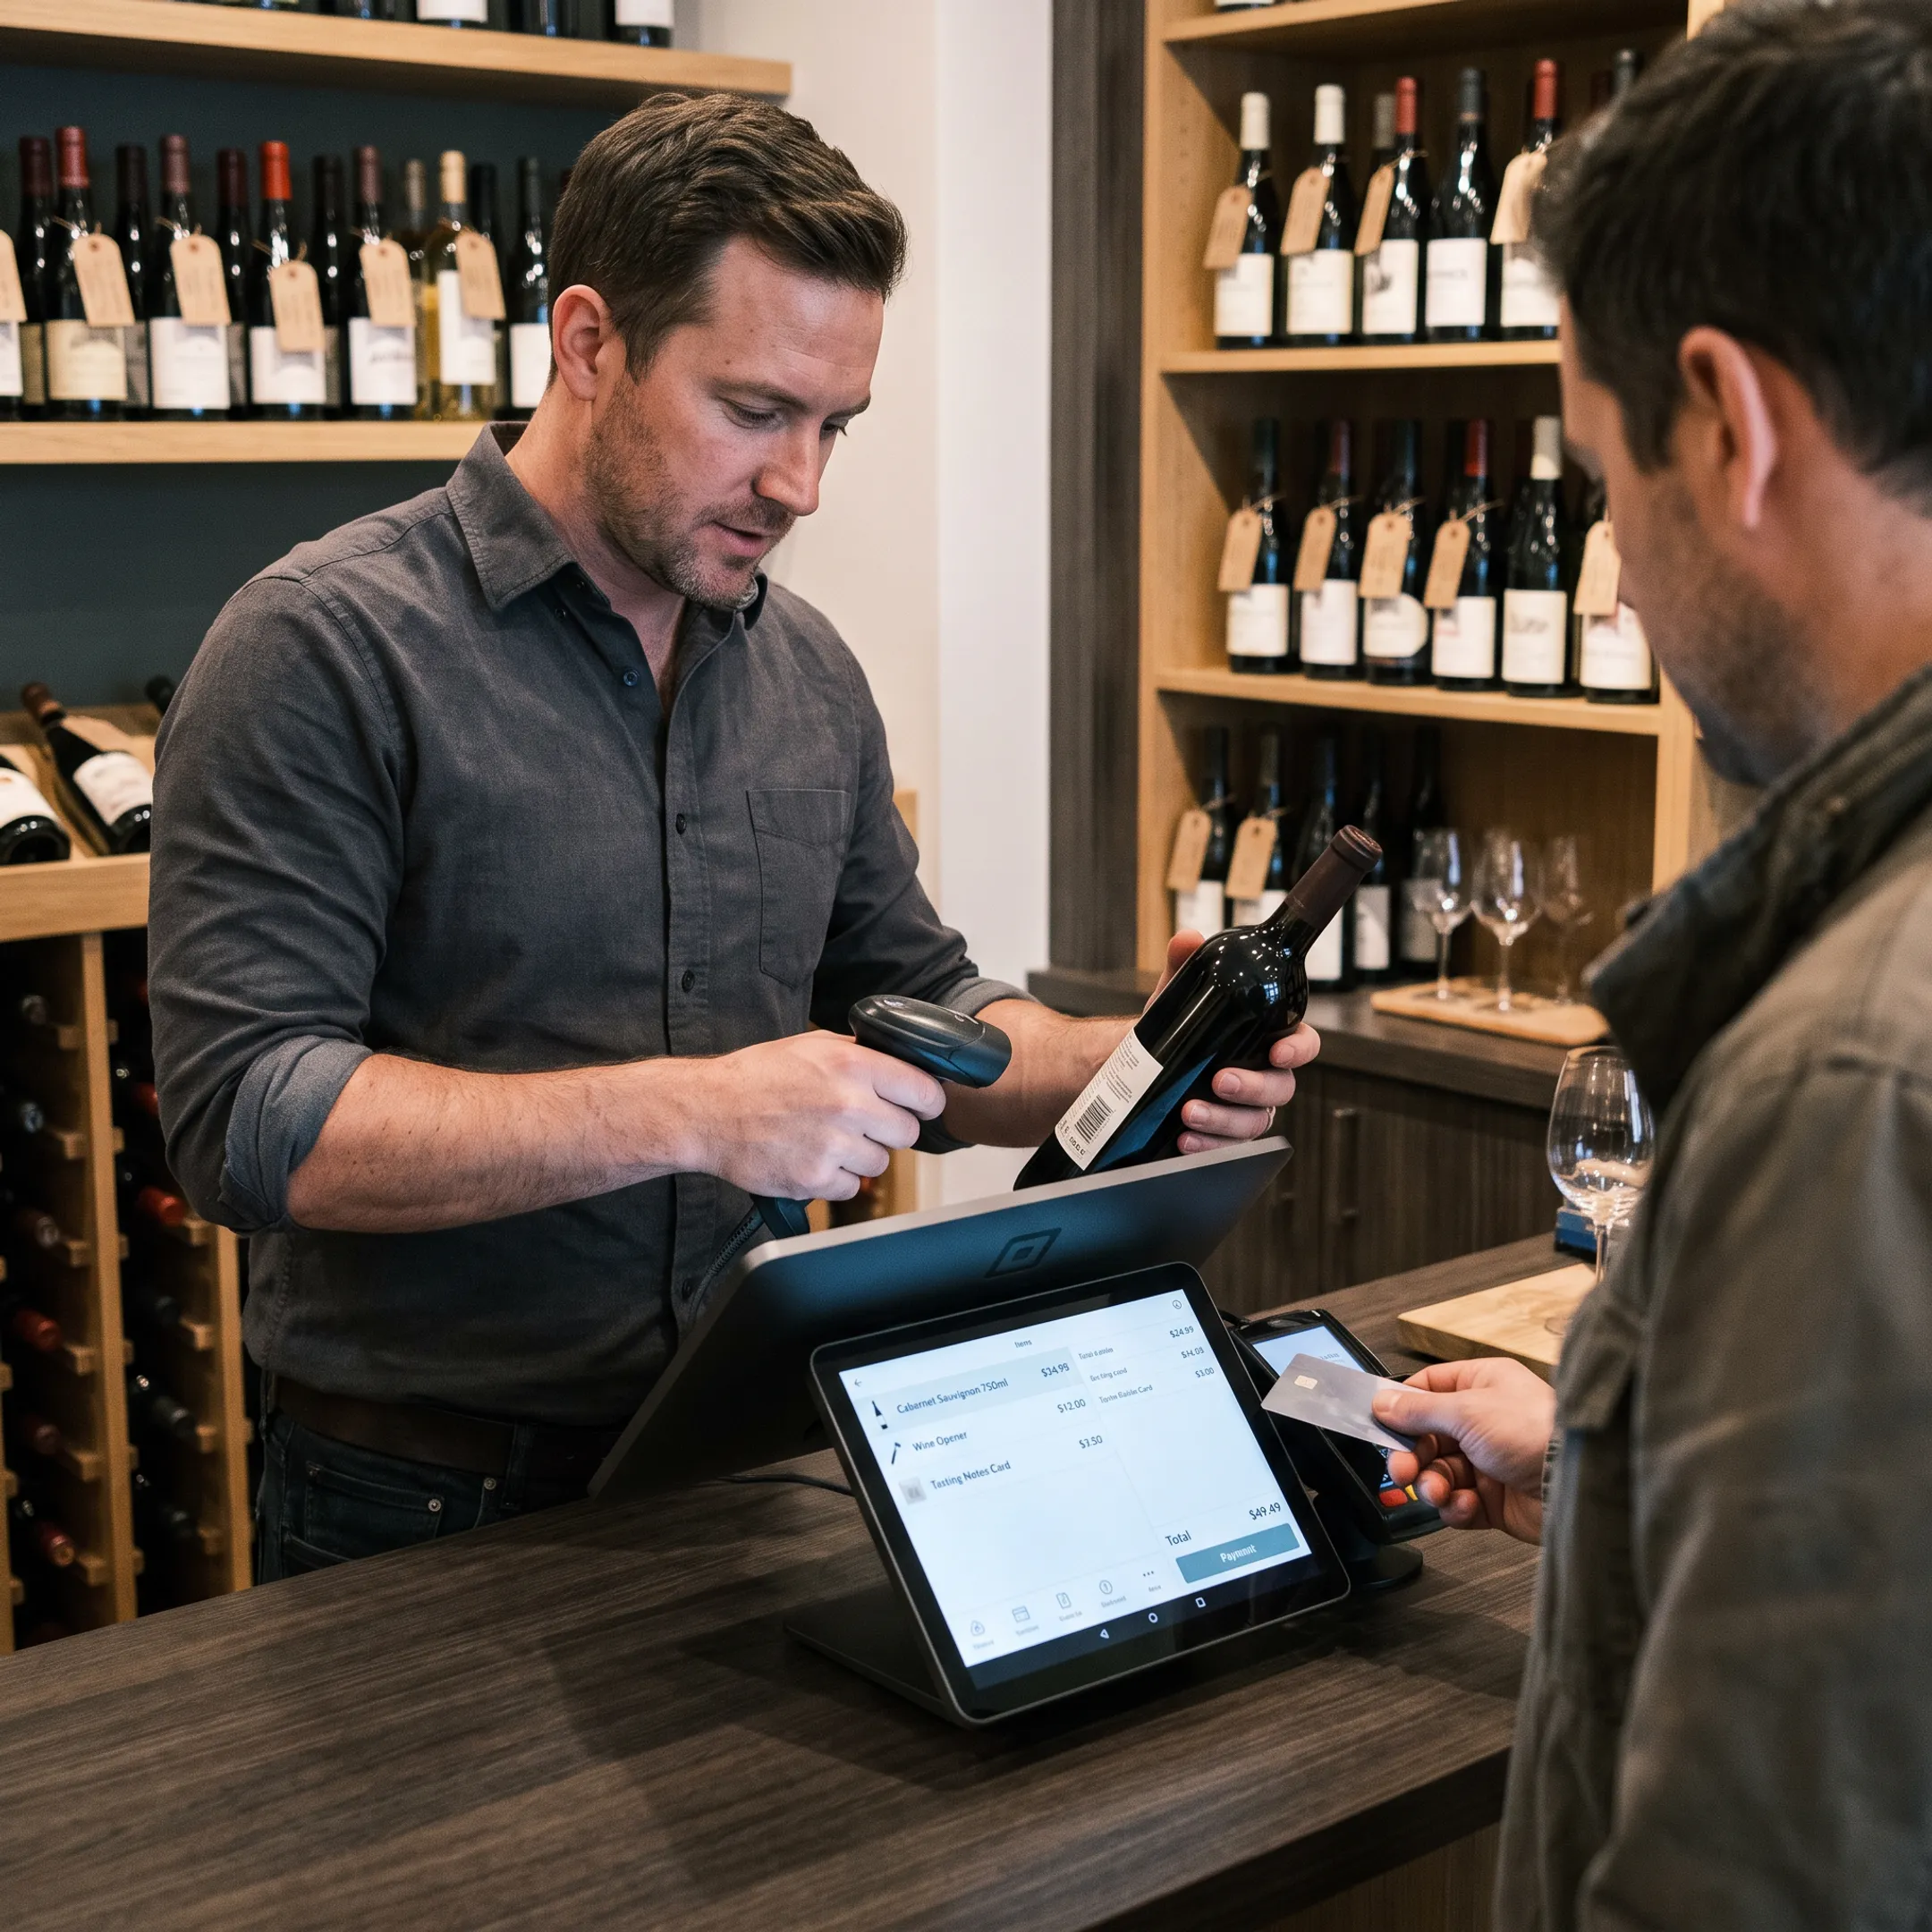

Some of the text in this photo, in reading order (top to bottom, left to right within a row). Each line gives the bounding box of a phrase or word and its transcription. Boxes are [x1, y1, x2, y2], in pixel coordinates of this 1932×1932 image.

[896, 1377, 1009, 1414] Cabernet Sauvignon 750ml
[1057, 1398, 1086, 1413] $12.00
[912, 1431, 968, 1452] Wine Opener
[930, 1460, 1012, 1490] Tasting Notes Card
[1249, 1502, 1282, 1521] $49.49
[1165, 1530, 1192, 1546] Total
